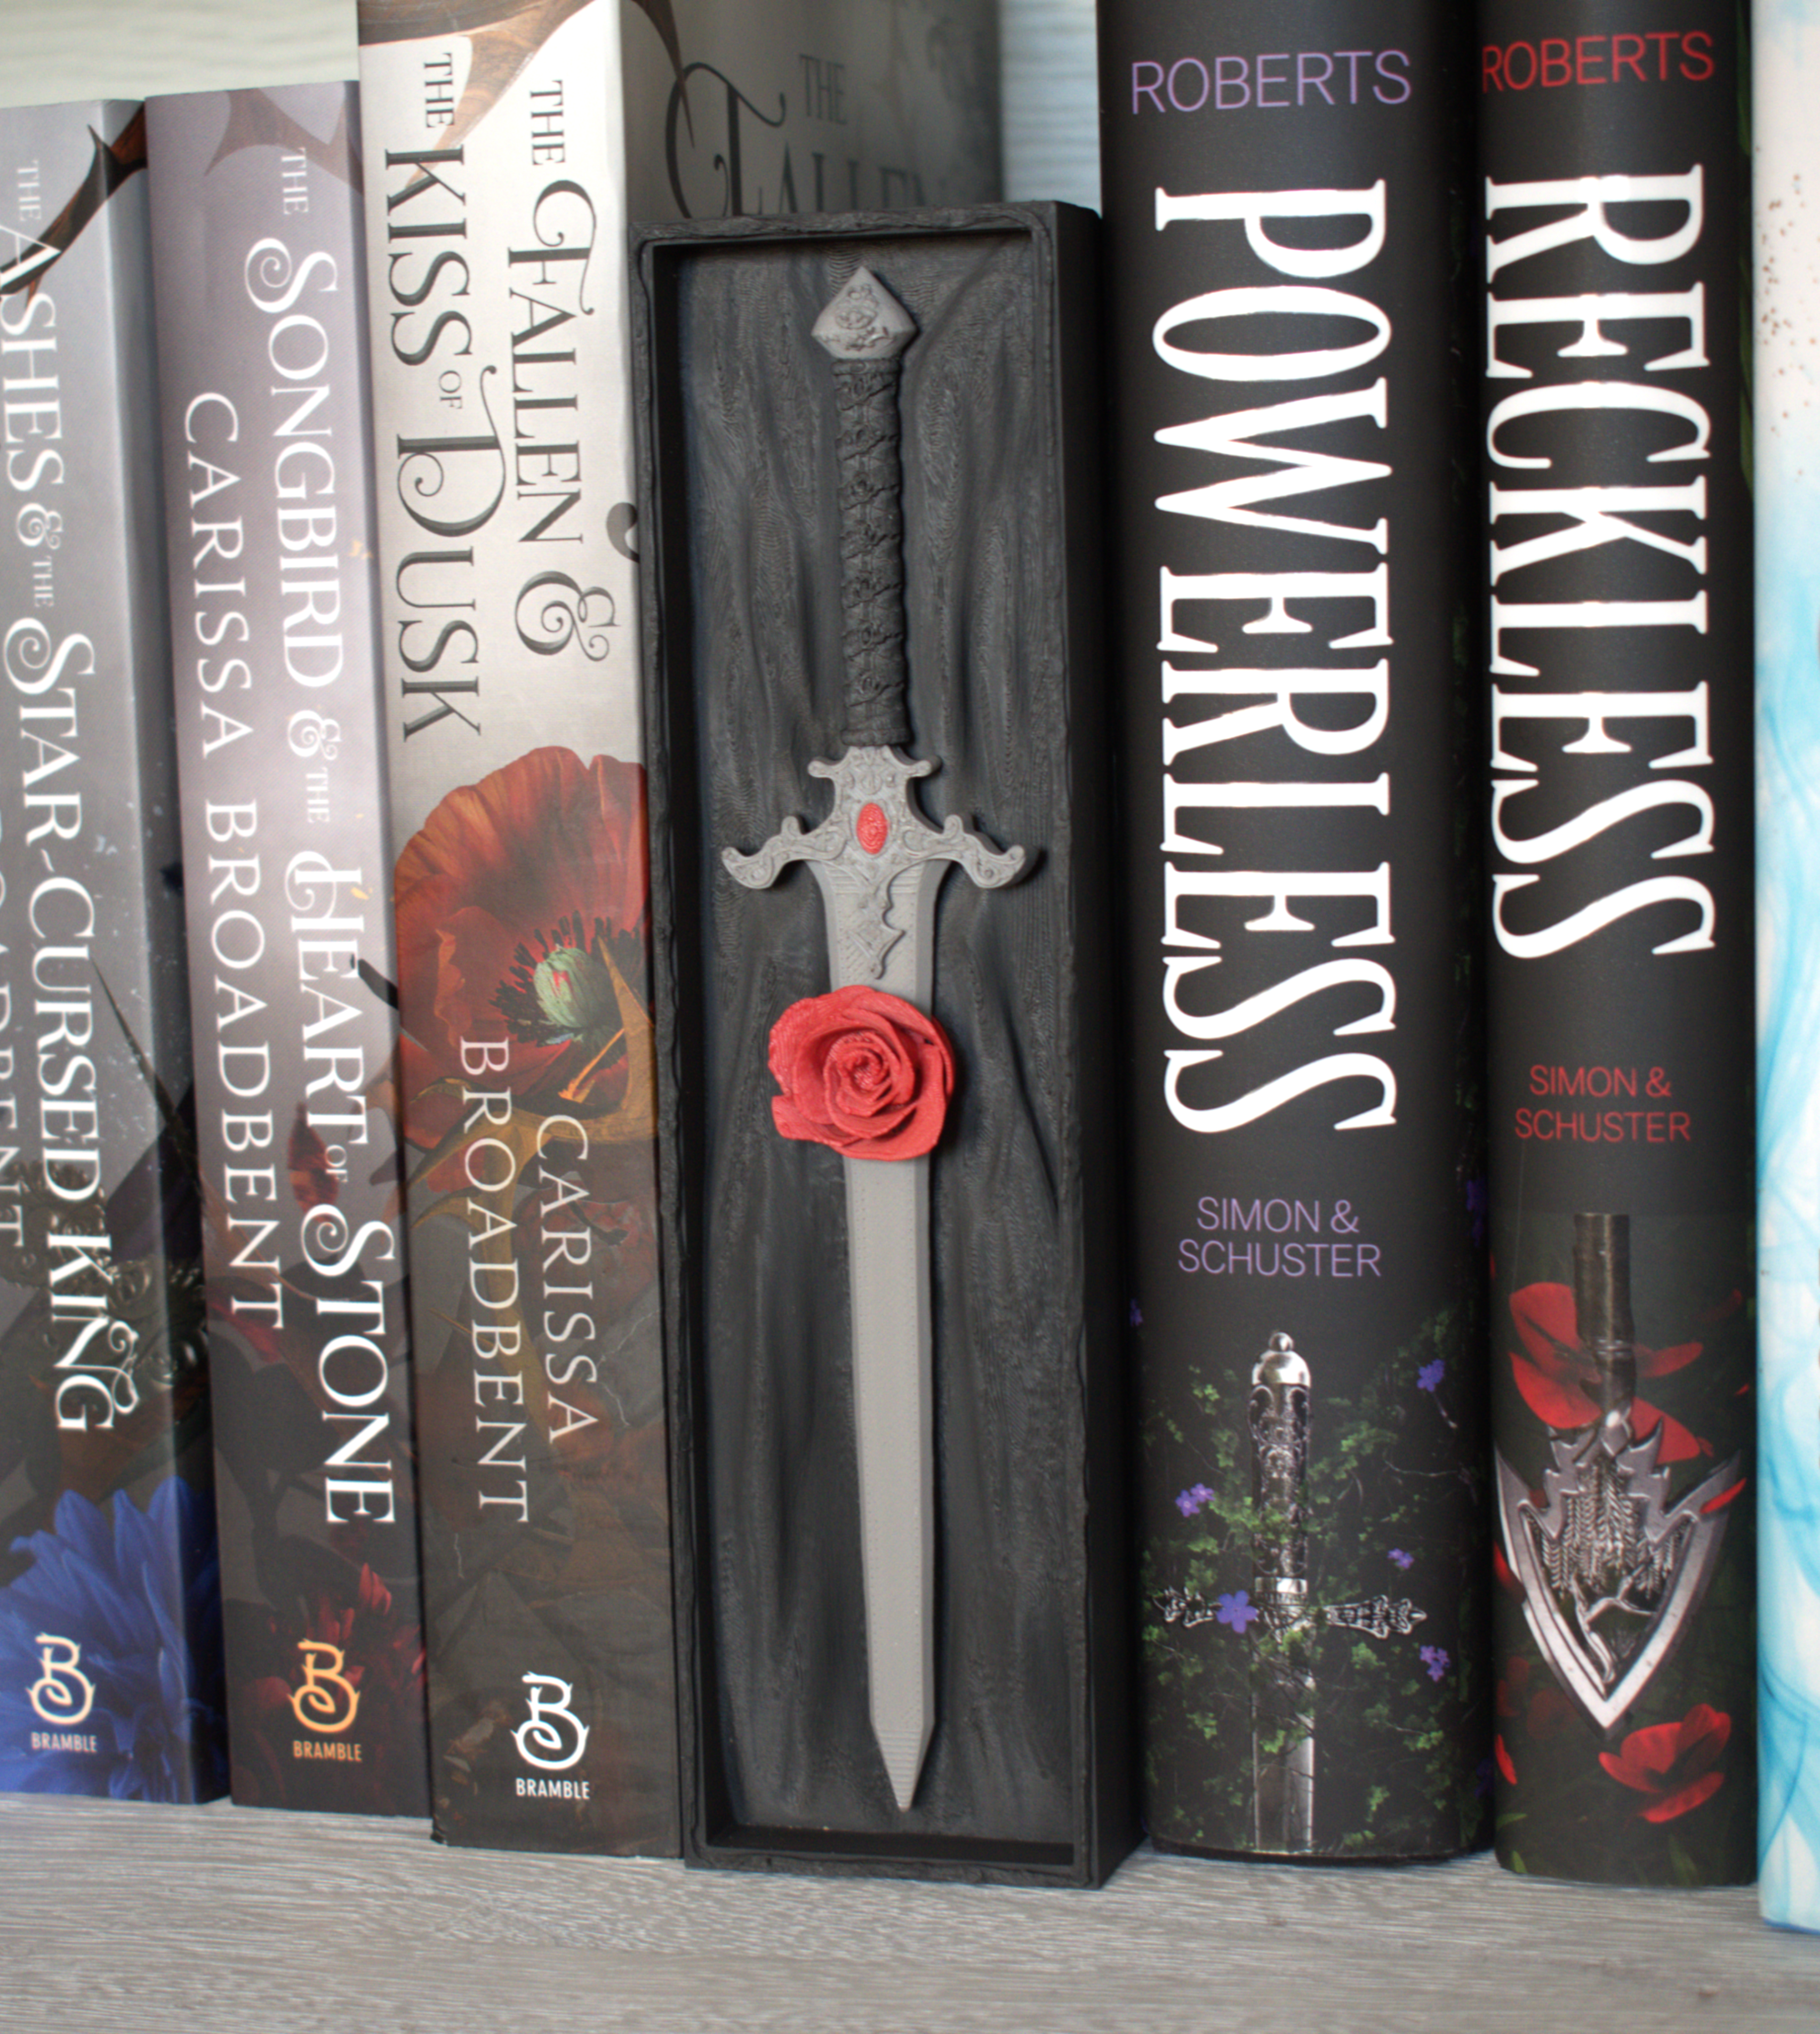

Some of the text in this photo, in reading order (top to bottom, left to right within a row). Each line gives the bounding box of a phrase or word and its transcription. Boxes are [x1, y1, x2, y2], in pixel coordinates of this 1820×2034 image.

[800, 54, 846, 124] THE
[1131, 49, 1412, 115] ROBERTS
[1481, 31, 1716, 95] ROBERTS
[16, 159, 42, 221] THE
[0, 225, 65, 493] ASHES
[508, 80, 621, 662] THE FALLEN &
[386, 52, 506, 742] THE KISS OF DUSK
[15, 502, 63, 550] &
[32, 556, 54, 608] THE
[1486, 164, 1716, 960] RECKLESS
[1152, 179, 1397, 1133] POWERLESS
[185, 392, 284, 1330] CARISSA BROADBENT
[244, 147, 396, 1524] THE SONGBIRD & THE HEART OF STONE
[4, 617, 102, 1201] STAR-CURSED
[1529, 1065, 1672, 1097] SIMON &
[1514, 1108, 1691, 1142] SCHUSTER
[1196, 1196, 1360, 1234] SIMON &
[460, 1036, 529, 1523] BROADBENT
[536, 1113, 599, 1445] CARISSA
[1177, 1239, 1381, 1277] SCHUSTER
[47, 1232, 140, 1431] KING
[30, 1731, 98, 1753] BRAMBLE
[293, 1740, 362, 1762] BRAMBLE
[515, 1778, 590, 1800] BRAMBLE
